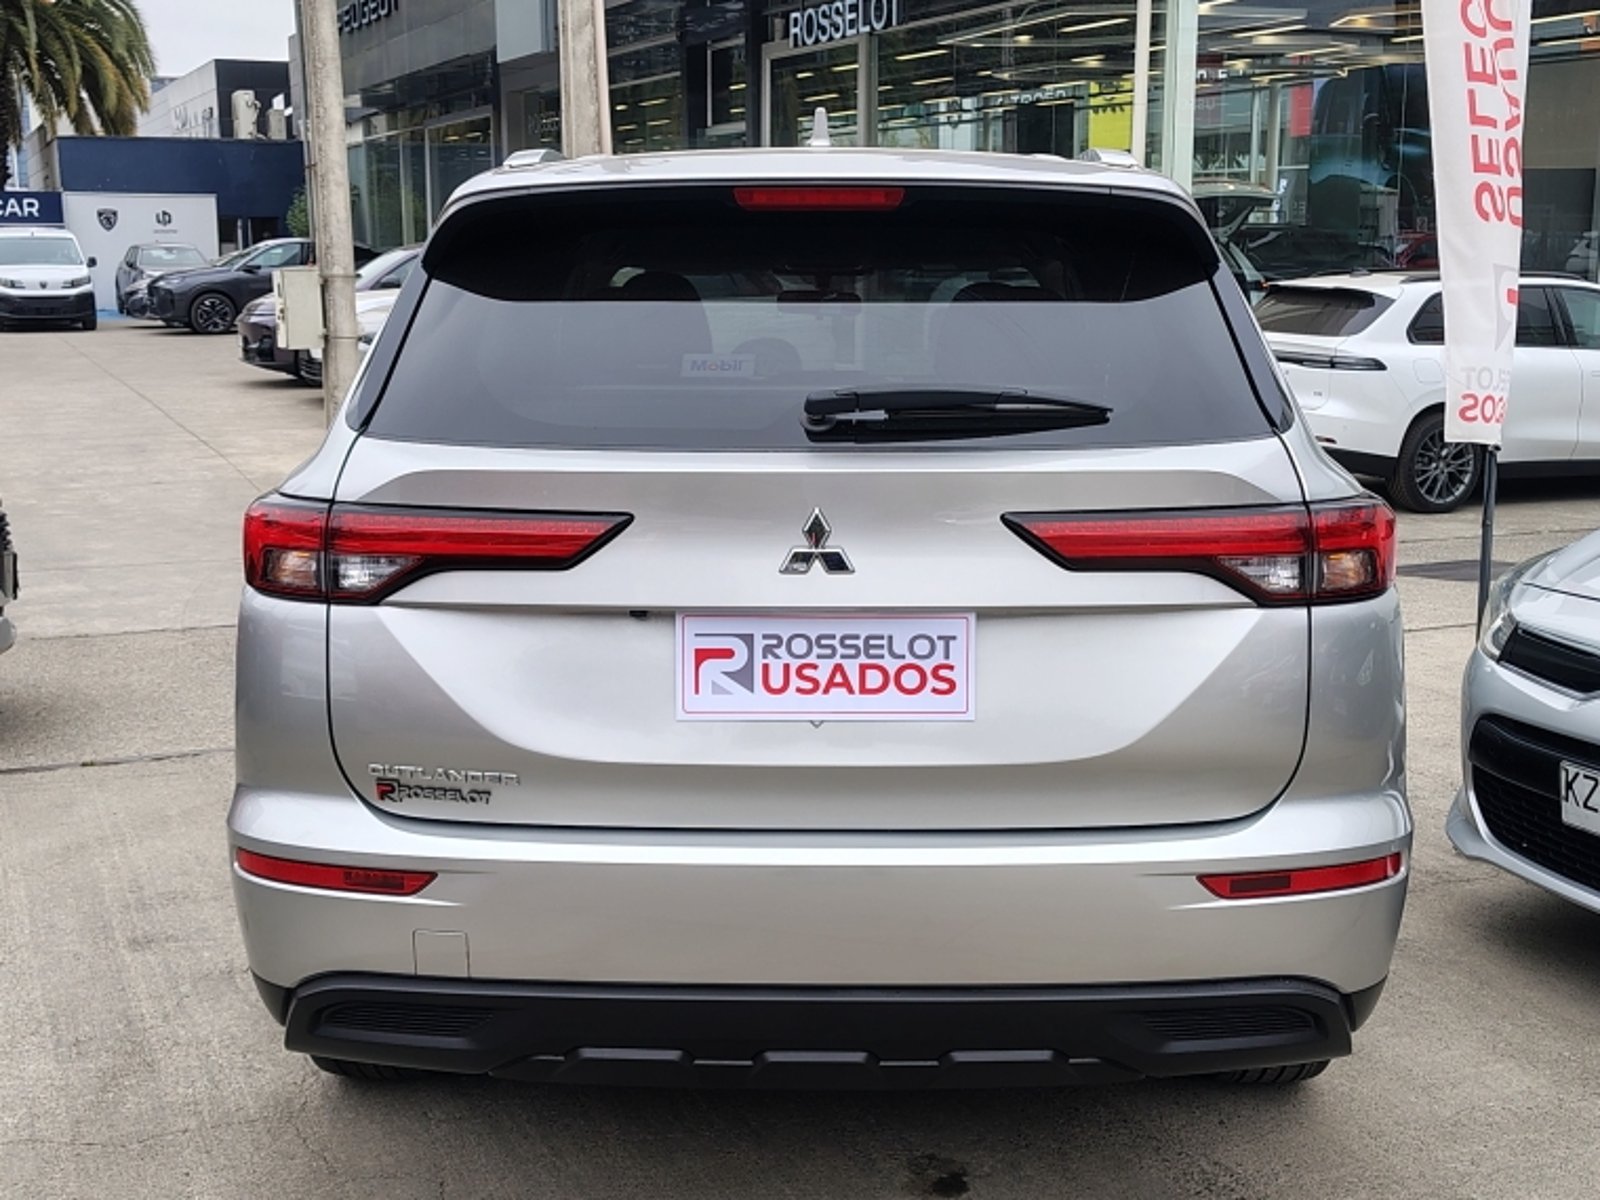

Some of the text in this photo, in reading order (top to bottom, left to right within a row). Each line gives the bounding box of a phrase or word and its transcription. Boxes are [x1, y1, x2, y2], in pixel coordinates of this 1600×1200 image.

[689, 359, 743, 372] Mobil
[761, 634, 957, 660] ROSSELOT
[761, 663, 957, 696] USADOS
[368, 763, 521, 786] OUTLANDER
[398, 784, 492, 804] ROSSELOT
